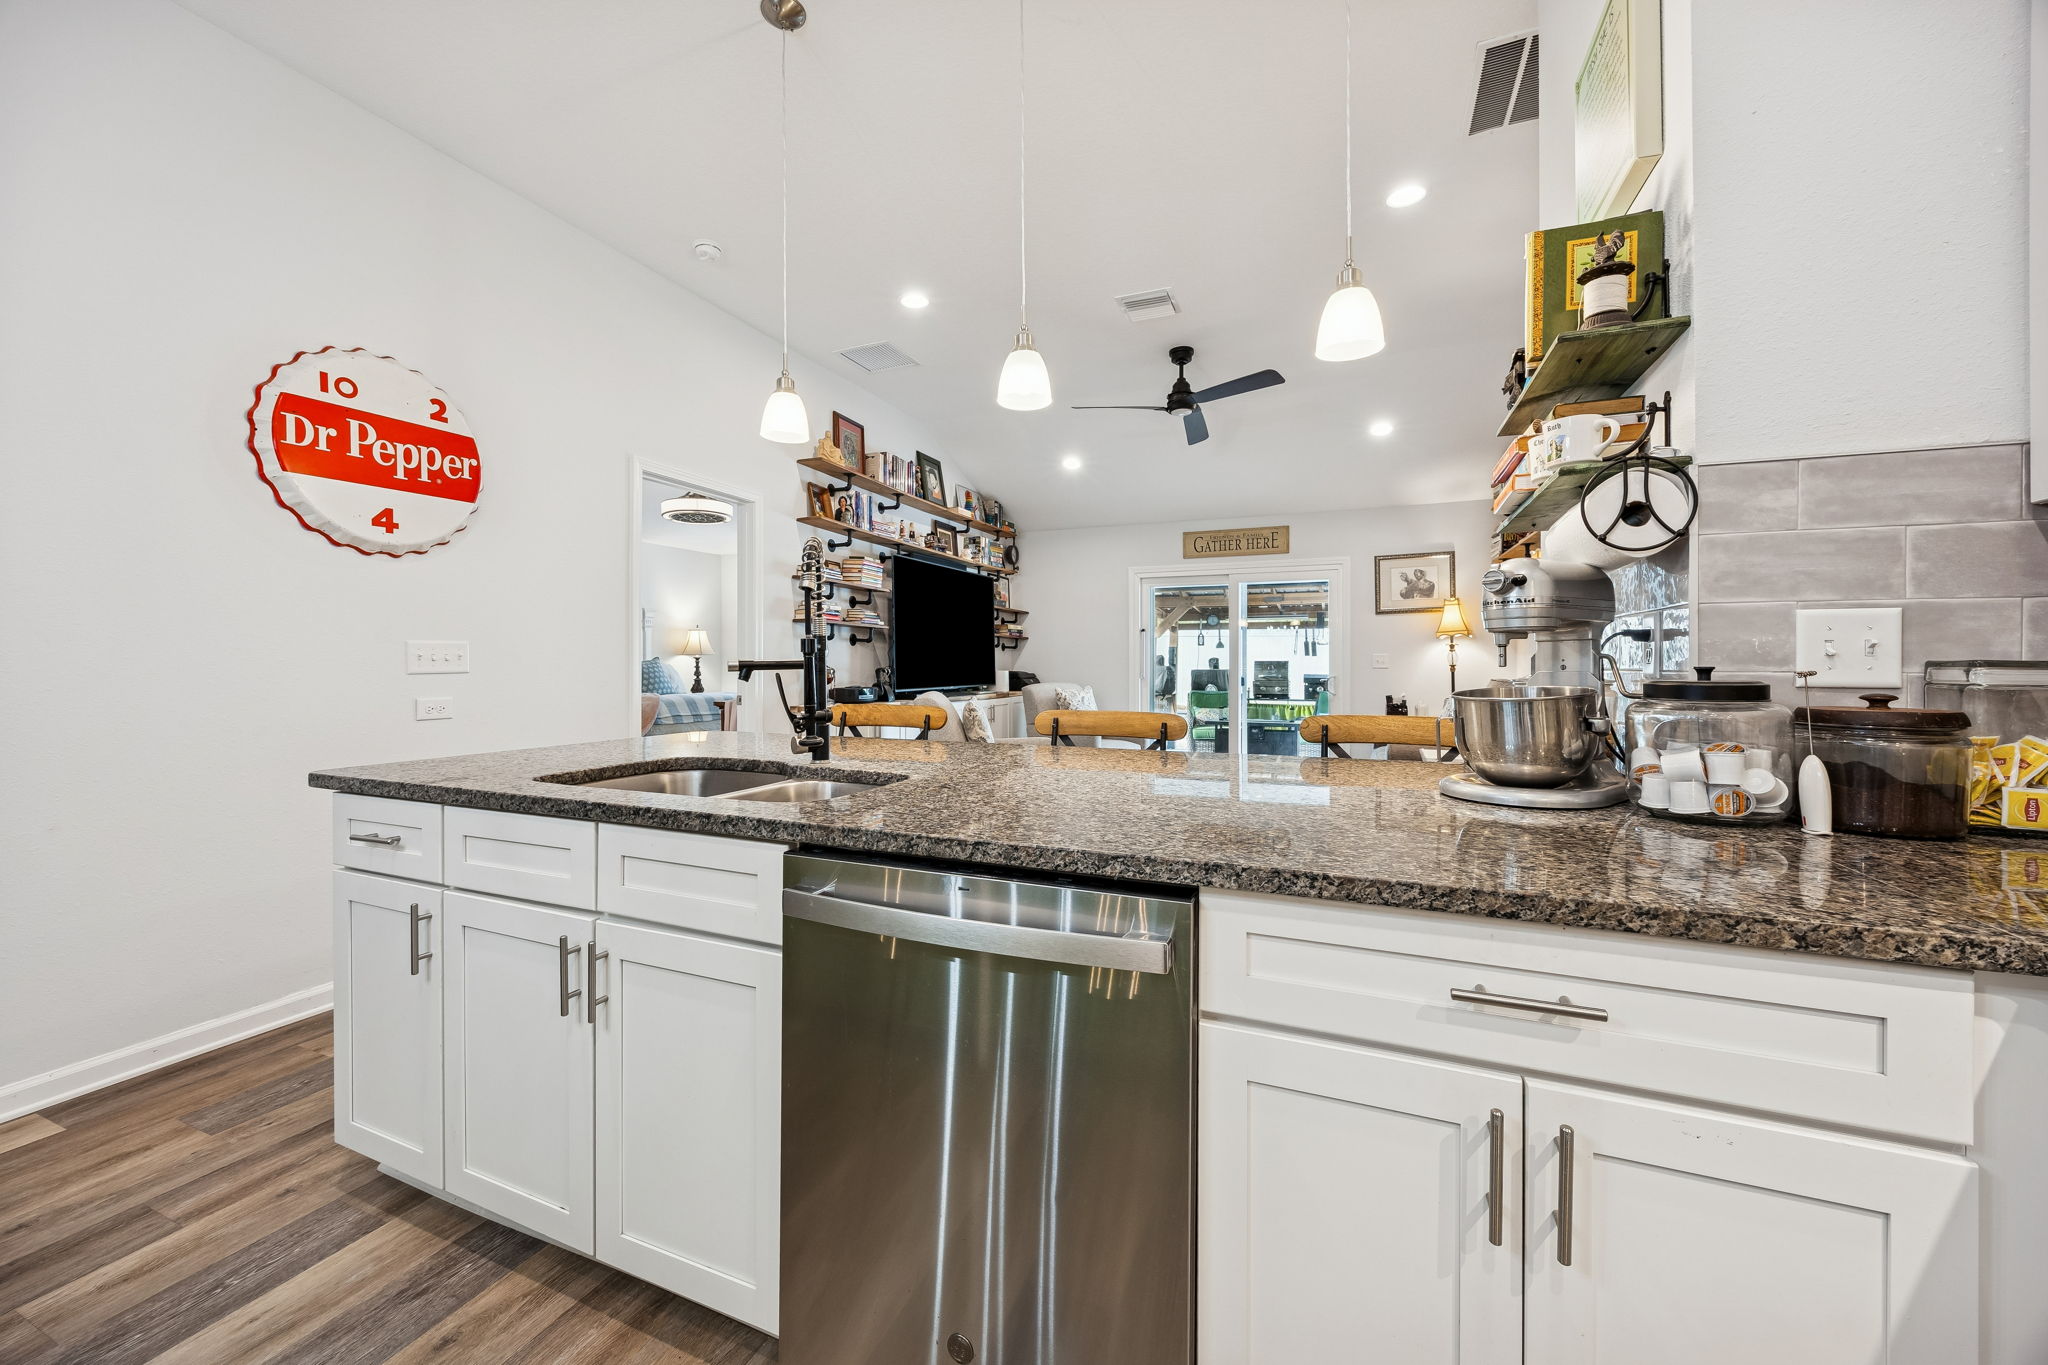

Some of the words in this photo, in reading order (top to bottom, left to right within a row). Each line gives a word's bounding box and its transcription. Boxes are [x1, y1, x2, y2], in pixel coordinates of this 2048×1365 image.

[319, 370, 359, 399] 10
[428, 398, 449, 424] 2
[280, 411, 337, 452] Dr
[346, 417, 478, 483] Pepper
[371, 507, 400, 534] 4
[1193, 536, 1242, 553] GATHER
[1246, 531, 1279, 550] HERE
[2028, 800, 2037, 820] Lipton
